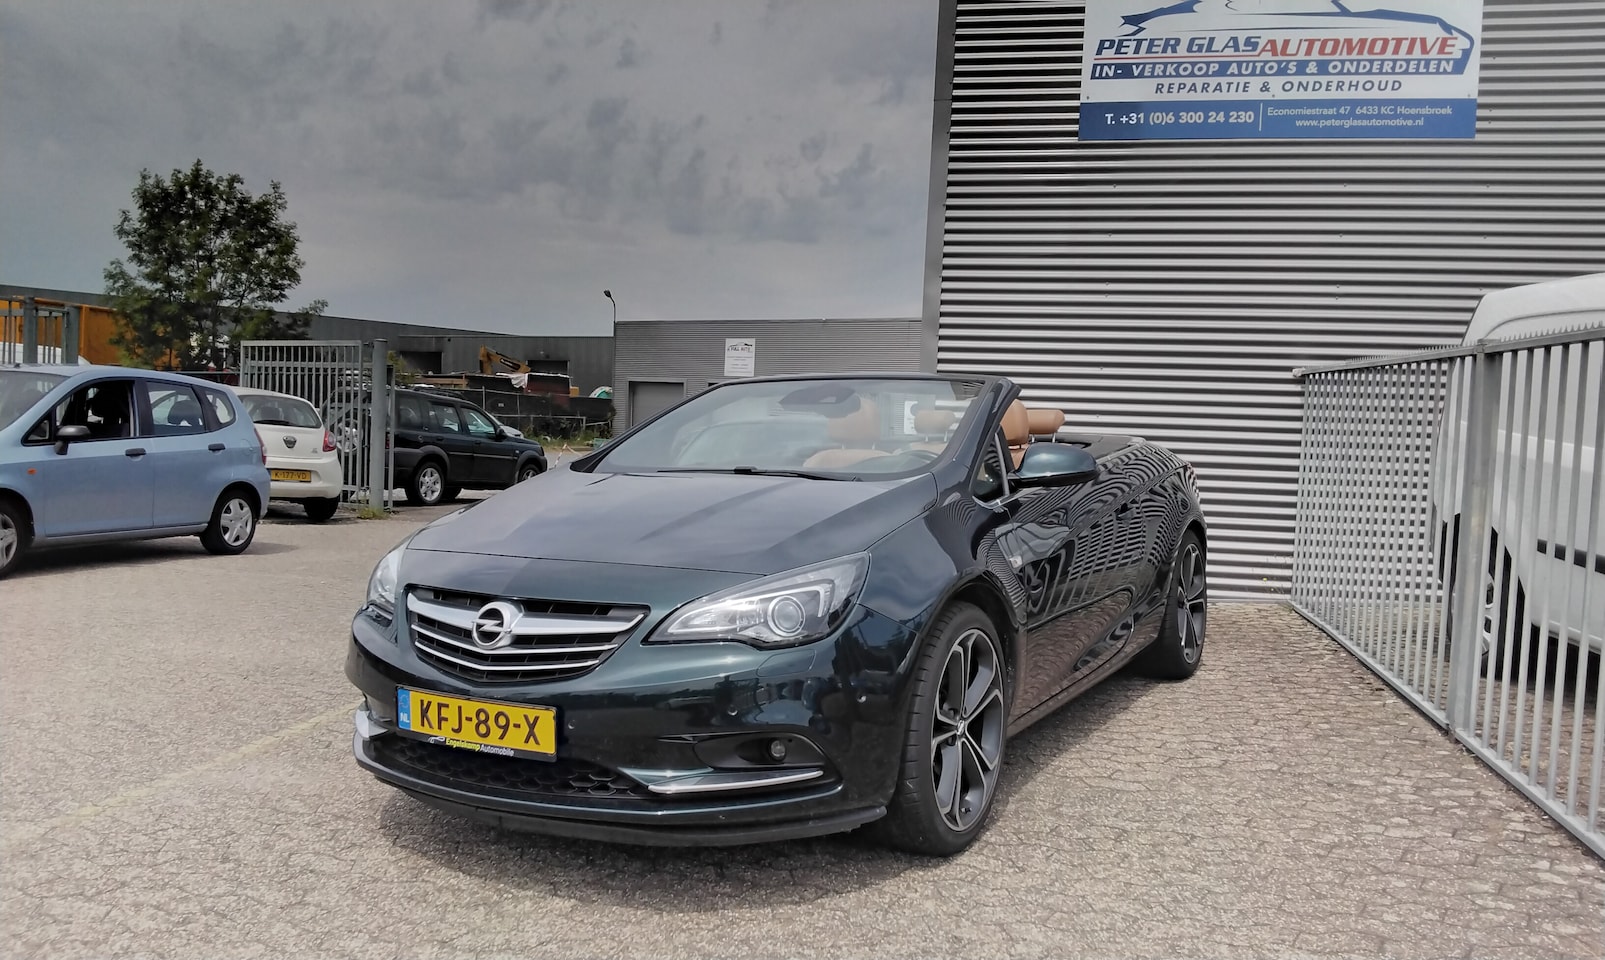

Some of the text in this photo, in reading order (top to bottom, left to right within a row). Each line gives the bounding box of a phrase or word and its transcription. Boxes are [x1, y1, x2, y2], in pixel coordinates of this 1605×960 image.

[1095, 37, 1182, 56] PETER
[1095, 60, 1454, 77] IN- VERKOOP AUTO'S & ONDERDELEN
[1155, 80, 1402, 94] REPARATIE & ONDERHOUD
[1267, 105, 1452, 116] Economiestraat 47 6433 KC Hoensbroek
[1105, 111, 1255, 125] T. +31 (0)6 300 24 230
[1295, 117, 1424, 128] www.peterglasautomotive.nl
[400, 712, 410, 723] NL
[420, 699, 541, 746] KFJ-89-X
